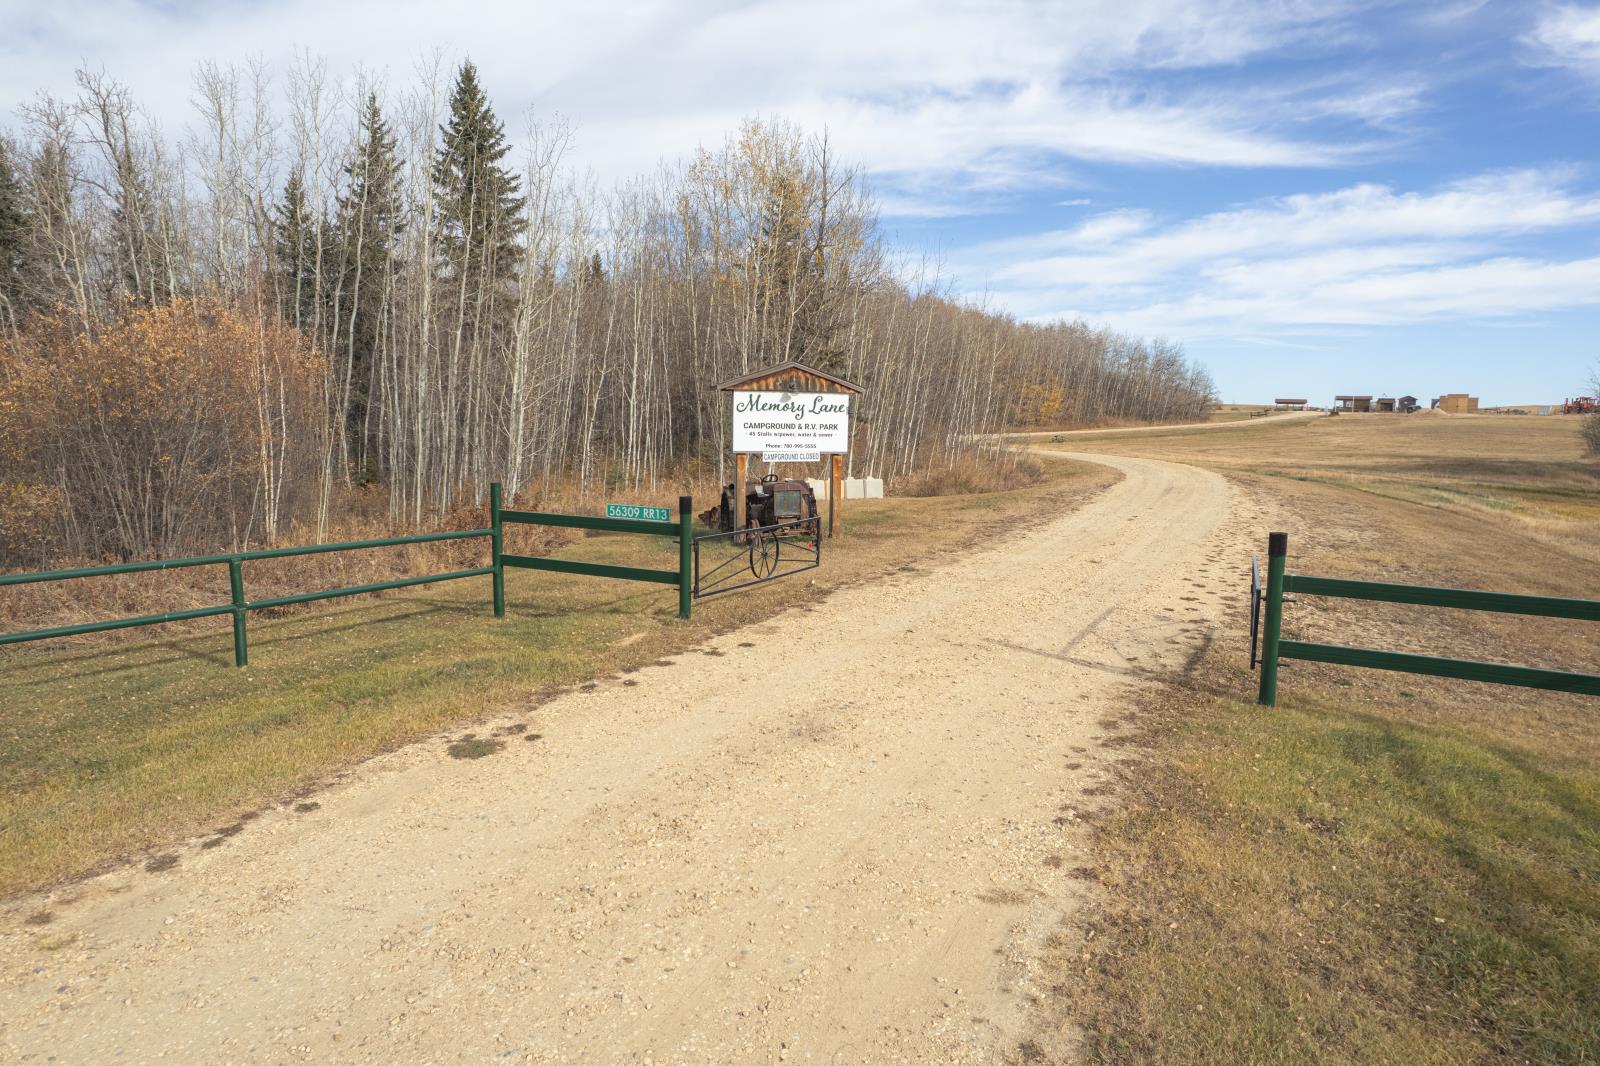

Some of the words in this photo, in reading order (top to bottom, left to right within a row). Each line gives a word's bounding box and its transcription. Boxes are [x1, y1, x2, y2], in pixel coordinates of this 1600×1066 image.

[736, 393, 805, 420] Memory
[808, 395, 846, 415] Lane
[743, 422, 796, 430] CAMPGROUND
[763, 453, 798, 461] CAMPGROUND
[799, 452, 820, 460] CLOSED
[609, 505, 640, 518] 56309
[643, 508, 667, 520] RR13
